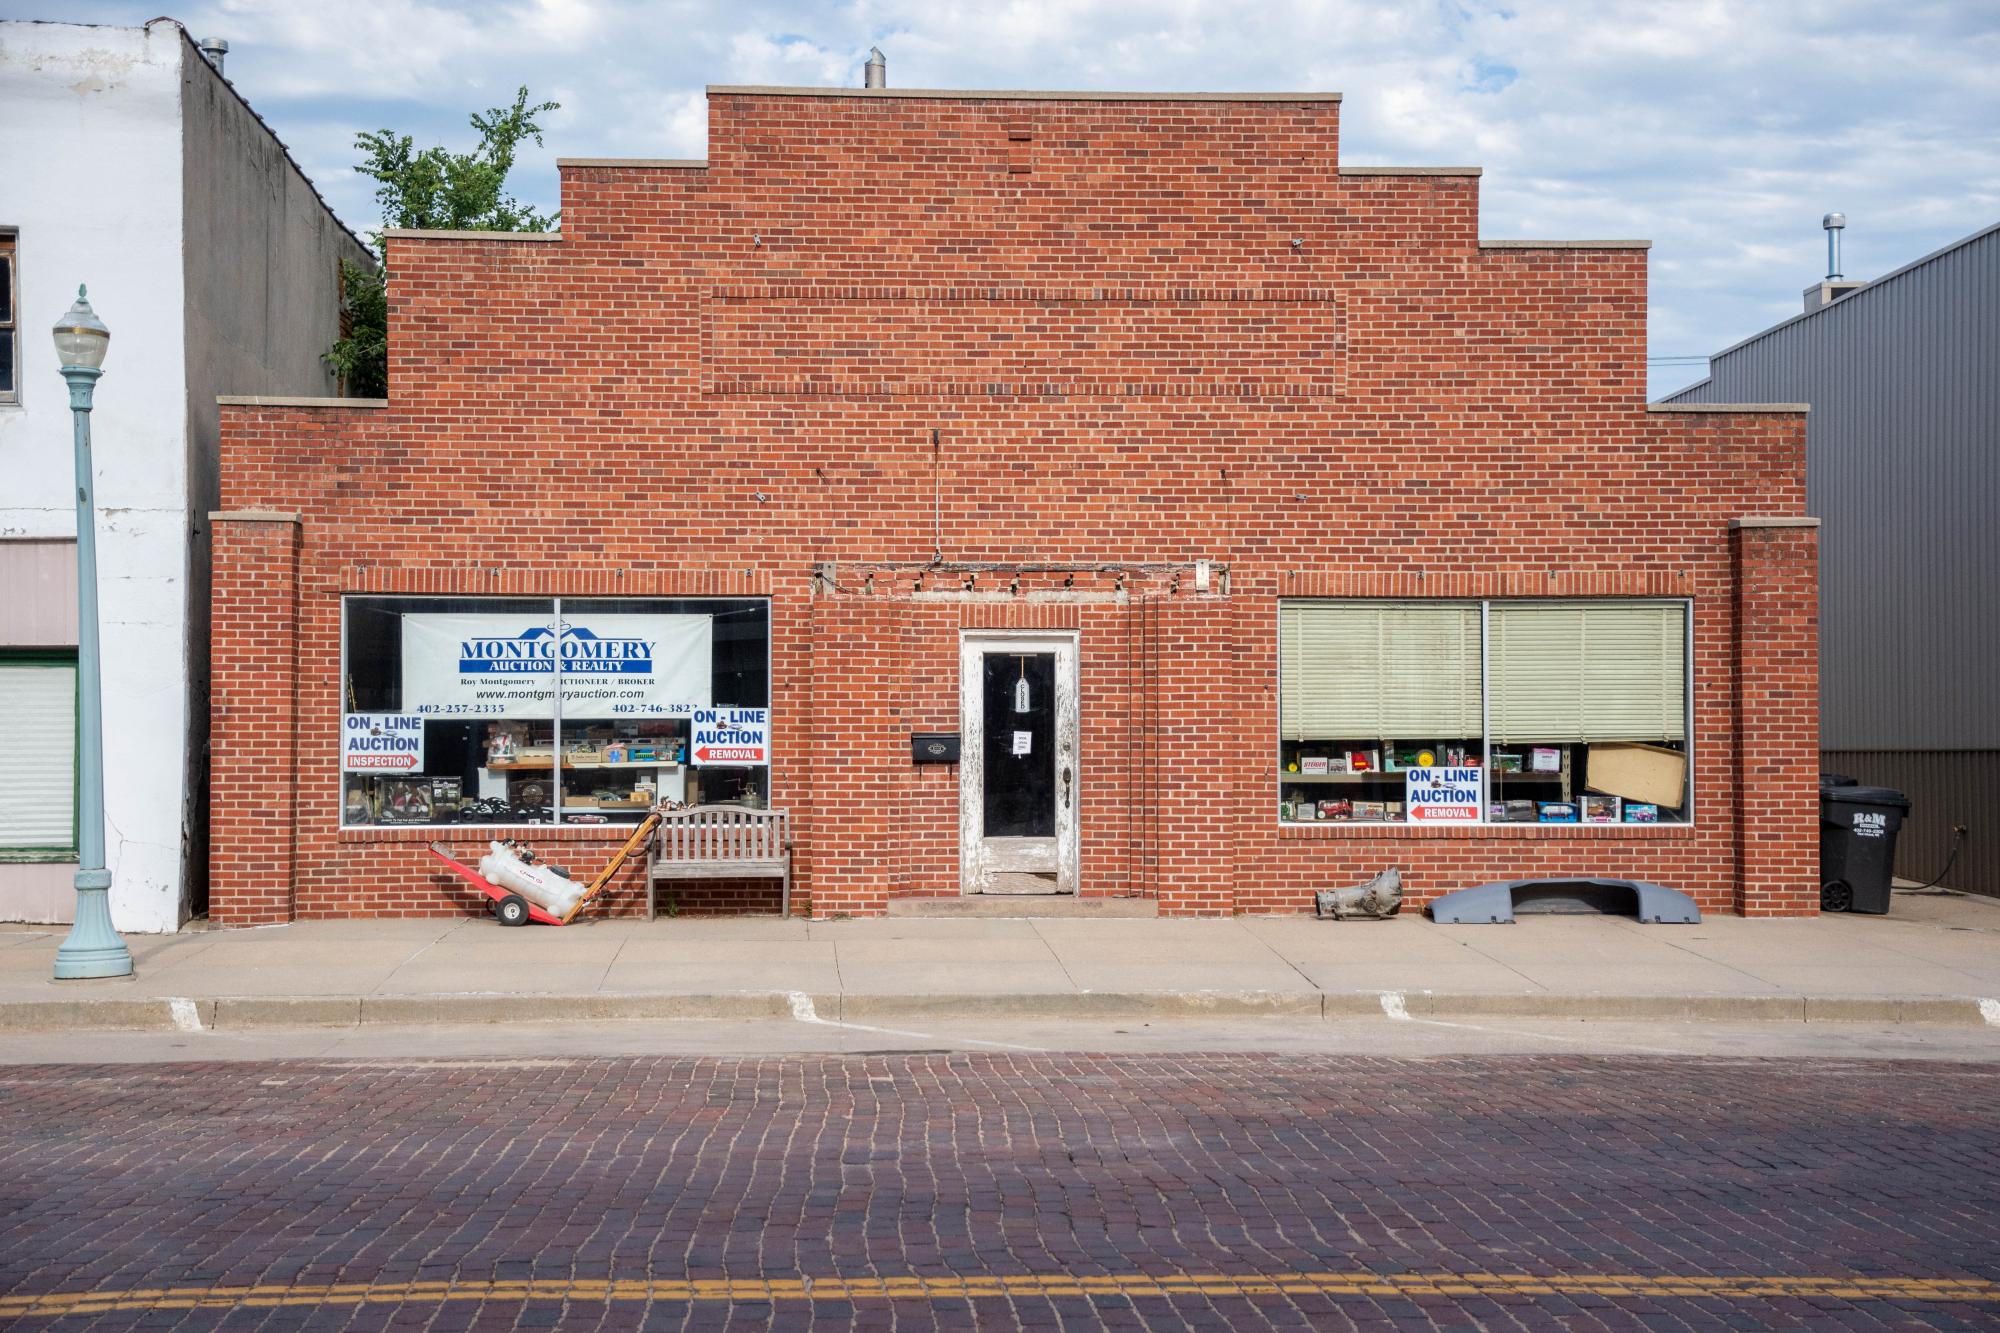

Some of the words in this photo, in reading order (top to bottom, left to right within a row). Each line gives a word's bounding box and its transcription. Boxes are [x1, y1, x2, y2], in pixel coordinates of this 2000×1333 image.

[460, 641, 656, 659] MONTGOMERY
[489, 661, 553, 671] AUCTION
[560, 661, 568, 671] &
[572, 661, 624, 671] REALTY
[461, 679, 477, 687] Roy
[480, 679, 536, 687] Montgomery
[416, 704, 505, 713] 402-257-2335
[694, 710, 717, 723] ON
[730, 710, 765, 723] LINE
[347, 717, 371, 730] ON
[384, 717, 422, 730] LINE
[695, 731, 763, 744] AUCTION
[348, 738, 419, 751] AUCTION
[709, 749, 757, 759] REMOVAL
[349, 756, 411, 767] INSPECTION
[1409, 769, 1431, 782] ON
[1444, 769, 1479, 782] LINE
[1410, 789, 1477, 803] AUCTION
[1424, 808, 1471, 818] REMOVAL
[1853, 812, 1886, 826] R&M
